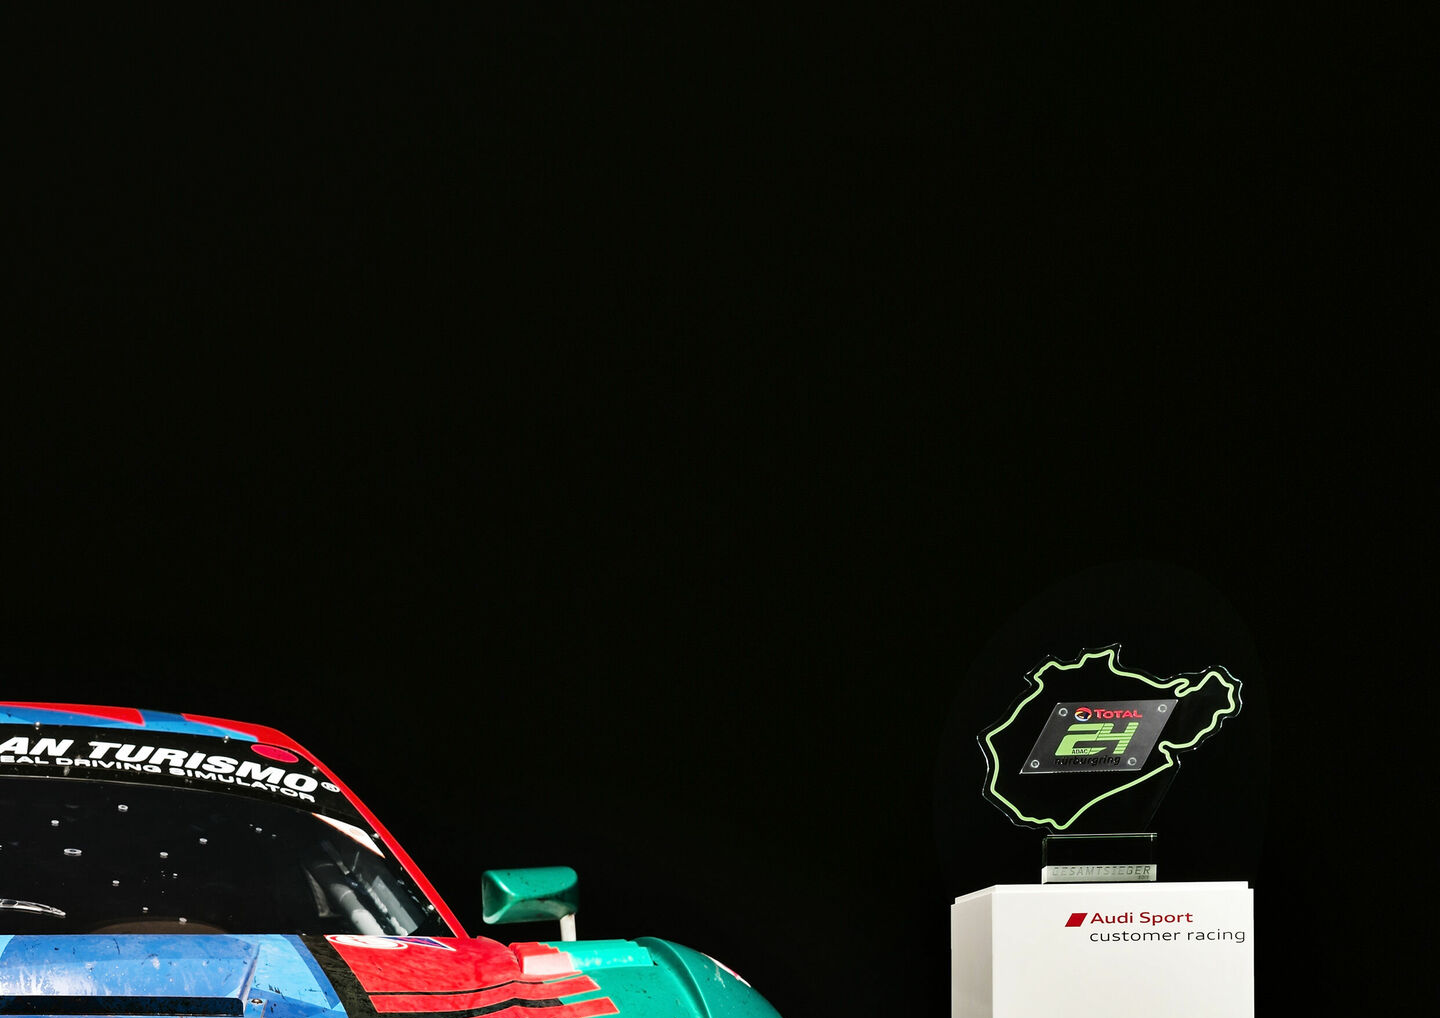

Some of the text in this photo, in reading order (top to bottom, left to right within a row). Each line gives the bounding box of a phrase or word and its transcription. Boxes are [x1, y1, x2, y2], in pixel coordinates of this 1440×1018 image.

[1093, 708, 1143, 719] TOTAL
[1055, 722, 1139, 756] 24
[56, 756, 162, 774] DRIVING
[168, 768, 316, 803] SIMULATOR
[1052, 866, 1151, 876] GESAMTSIEGER
[1090, 911, 1194, 926] Audi Sport
[1089, 929, 1246, 944] customer racing
